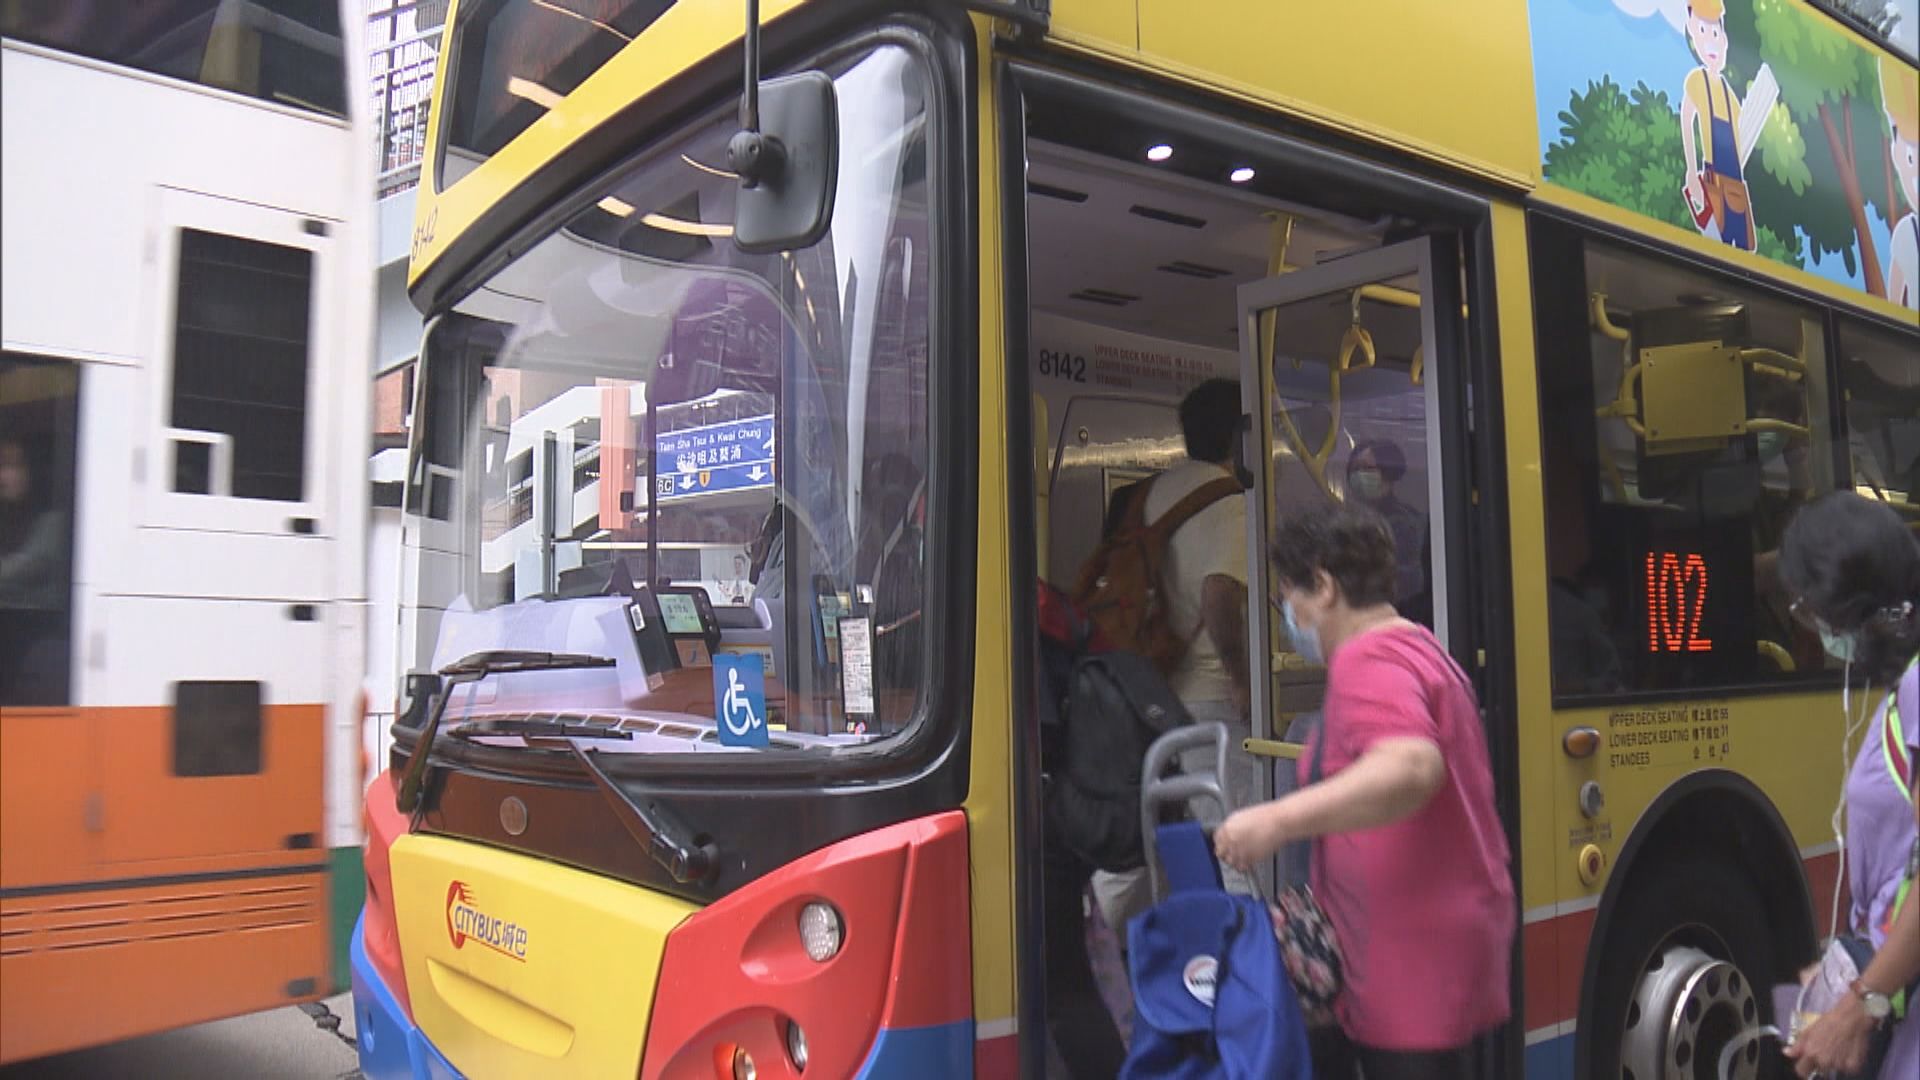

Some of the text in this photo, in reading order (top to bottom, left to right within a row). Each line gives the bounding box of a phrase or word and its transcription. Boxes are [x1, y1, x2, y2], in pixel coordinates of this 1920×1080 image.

[411, 206, 438, 262] 8142
[1039, 348, 1086, 383] 8142
[1120, 348, 1139, 361] DECK
[660, 441, 674, 452] Tsim
[677, 439, 690, 449] Sha
[693, 436, 706, 446] Tsui
[717, 431, 735, 442] Kwai
[738, 428, 761, 439] Chung
[1647, 552, 1712, 652] 102
[1609, 709, 1689, 727] UPPER DECK SEATING
[1609, 728, 1689, 748] LOWER DECK SEATING
[1610, 752, 1650, 767] STANDEES
[455, 905, 528, 957] CITYBUS 城巴
